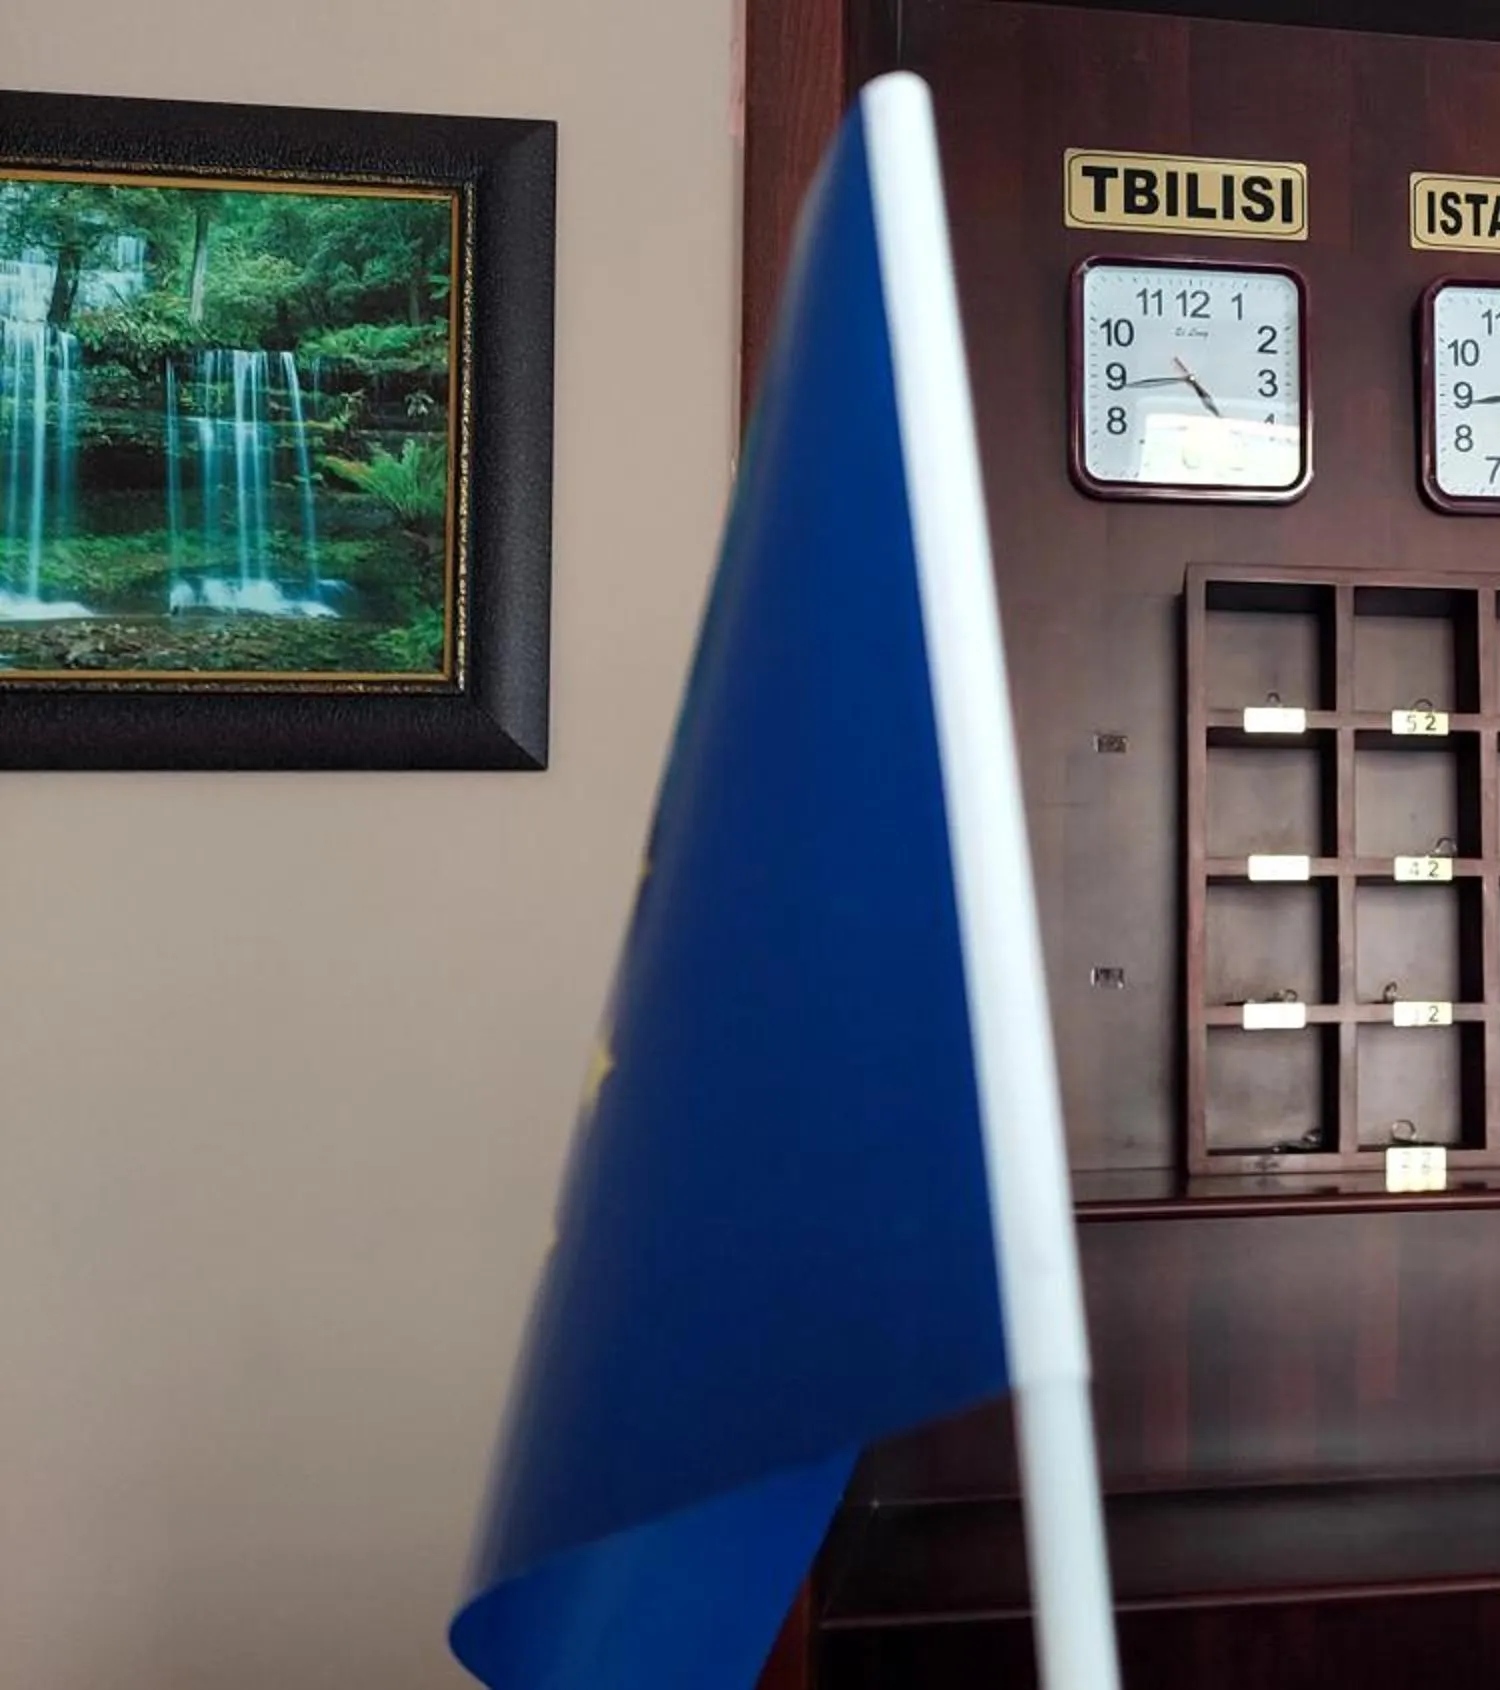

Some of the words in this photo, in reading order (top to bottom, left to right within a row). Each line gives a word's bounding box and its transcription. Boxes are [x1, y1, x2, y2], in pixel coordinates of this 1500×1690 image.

[1081, 165, 1294, 224] TBILISI
[1137, 288, 1162, 316] 11
[1176, 290, 1210, 318] 12
[1232, 293, 1242, 320] 1
[1101, 319, 1134, 347] 10
[1258, 326, 1277, 354] 2
[1448, 340, 1479, 366] 10
[1106, 363, 1126, 390] 9
[1259, 370, 1278, 397] 3
[1454, 382, 1473, 409] 9
[1107, 407, 1126, 434] 8
[1455, 425, 1473, 452] 8
[1405, 714, 1438, 733] 52
[1408, 861, 1440, 878] 42
